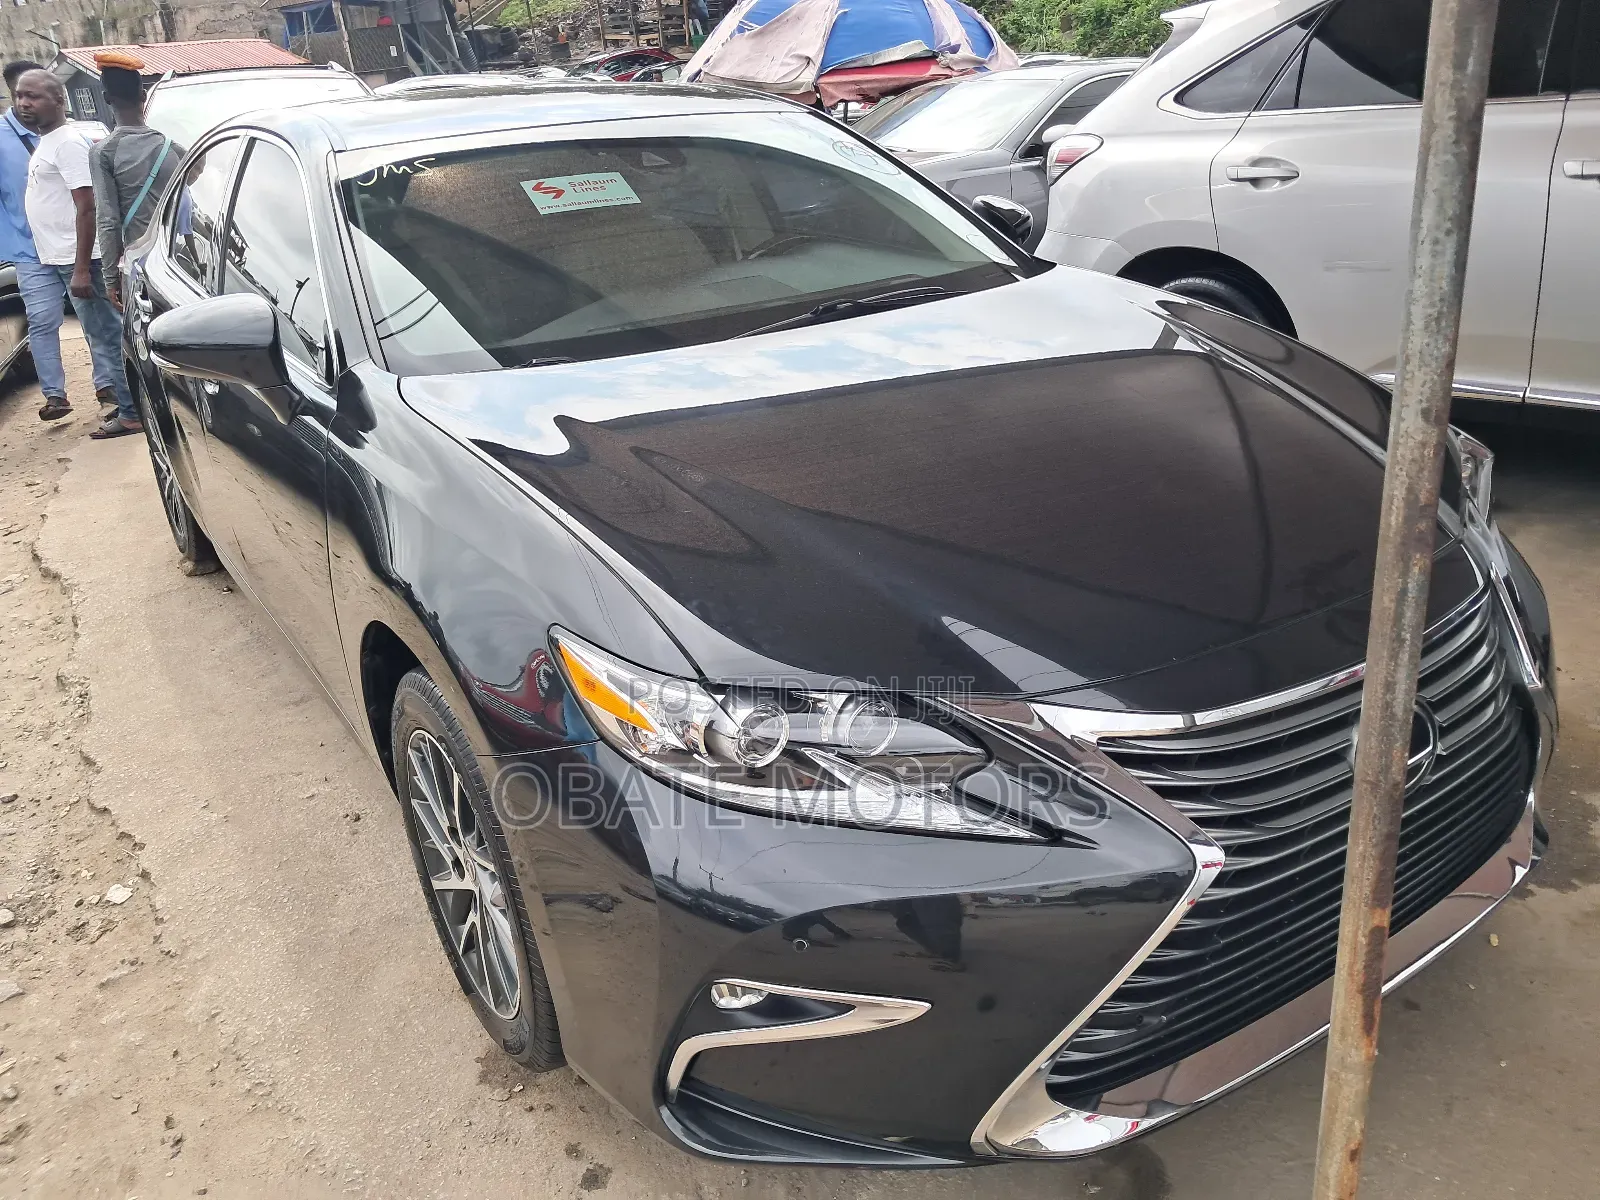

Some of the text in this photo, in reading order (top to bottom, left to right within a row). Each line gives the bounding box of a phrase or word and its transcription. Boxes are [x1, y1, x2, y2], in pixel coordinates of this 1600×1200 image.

[567, 178, 617, 188] Sallaum
[573, 184, 607, 194] Lines
[540, 196, 634, 211] www.sallaumlines.com
